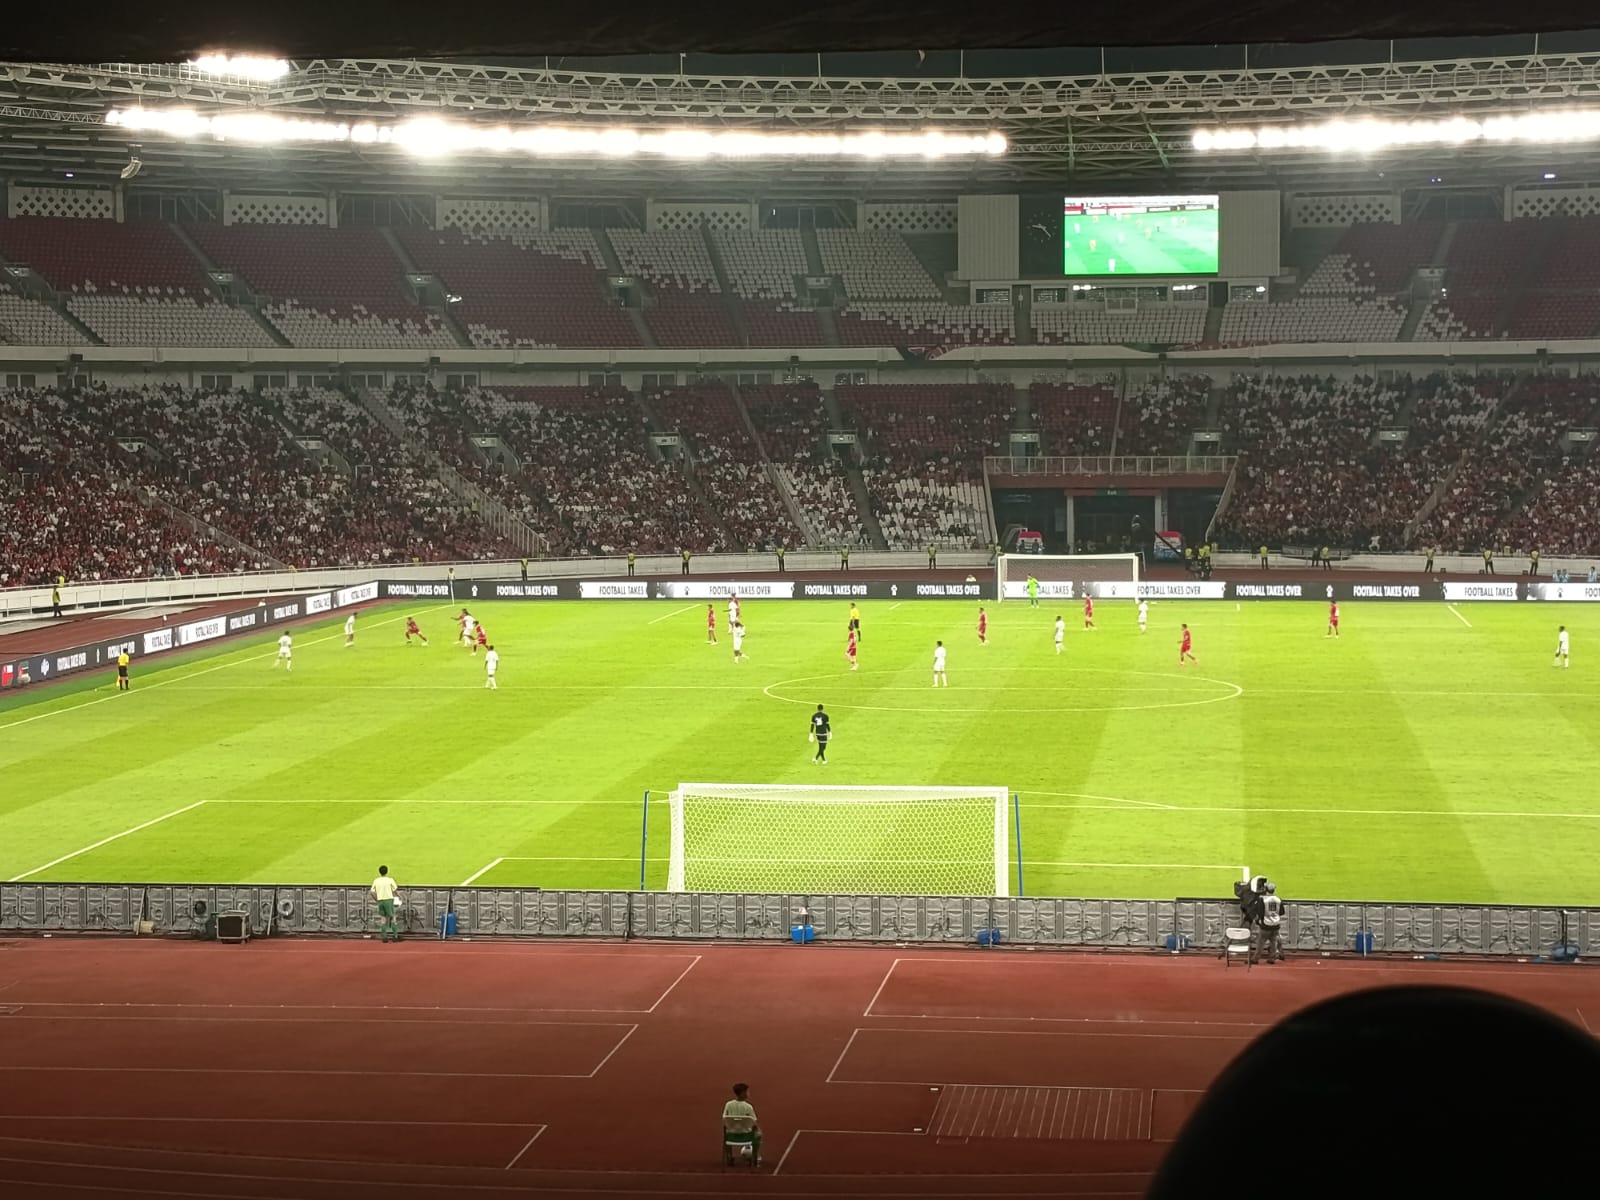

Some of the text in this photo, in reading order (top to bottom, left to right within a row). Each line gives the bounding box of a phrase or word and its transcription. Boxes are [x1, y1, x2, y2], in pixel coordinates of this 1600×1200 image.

[387, 584, 449, 595] FOOTBALL TAKES OVER
[496, 585, 558, 596] FOOTBALL TAKES OVER
[599, 586, 644, 595] FOOTBALL TAKES
[709, 586, 771, 595] FOOTBALL TAKES OVER
[804, 585, 868, 595] FOOTBALL TAKES OVER
[917, 585, 980, 595] FOOTBALL TAKES OVER
[1052, 585, 1069, 595] TAKES
[1137, 586, 1201, 595] FOOTBALL TAKES OVER
[1236, 585, 1302, 596] FOOTBALL TAKES OVER
[1353, 585, 1420, 597] FOOTBALL TAKES OVER
[1464, 587, 1513, 597] FOOTBALL TAKES
